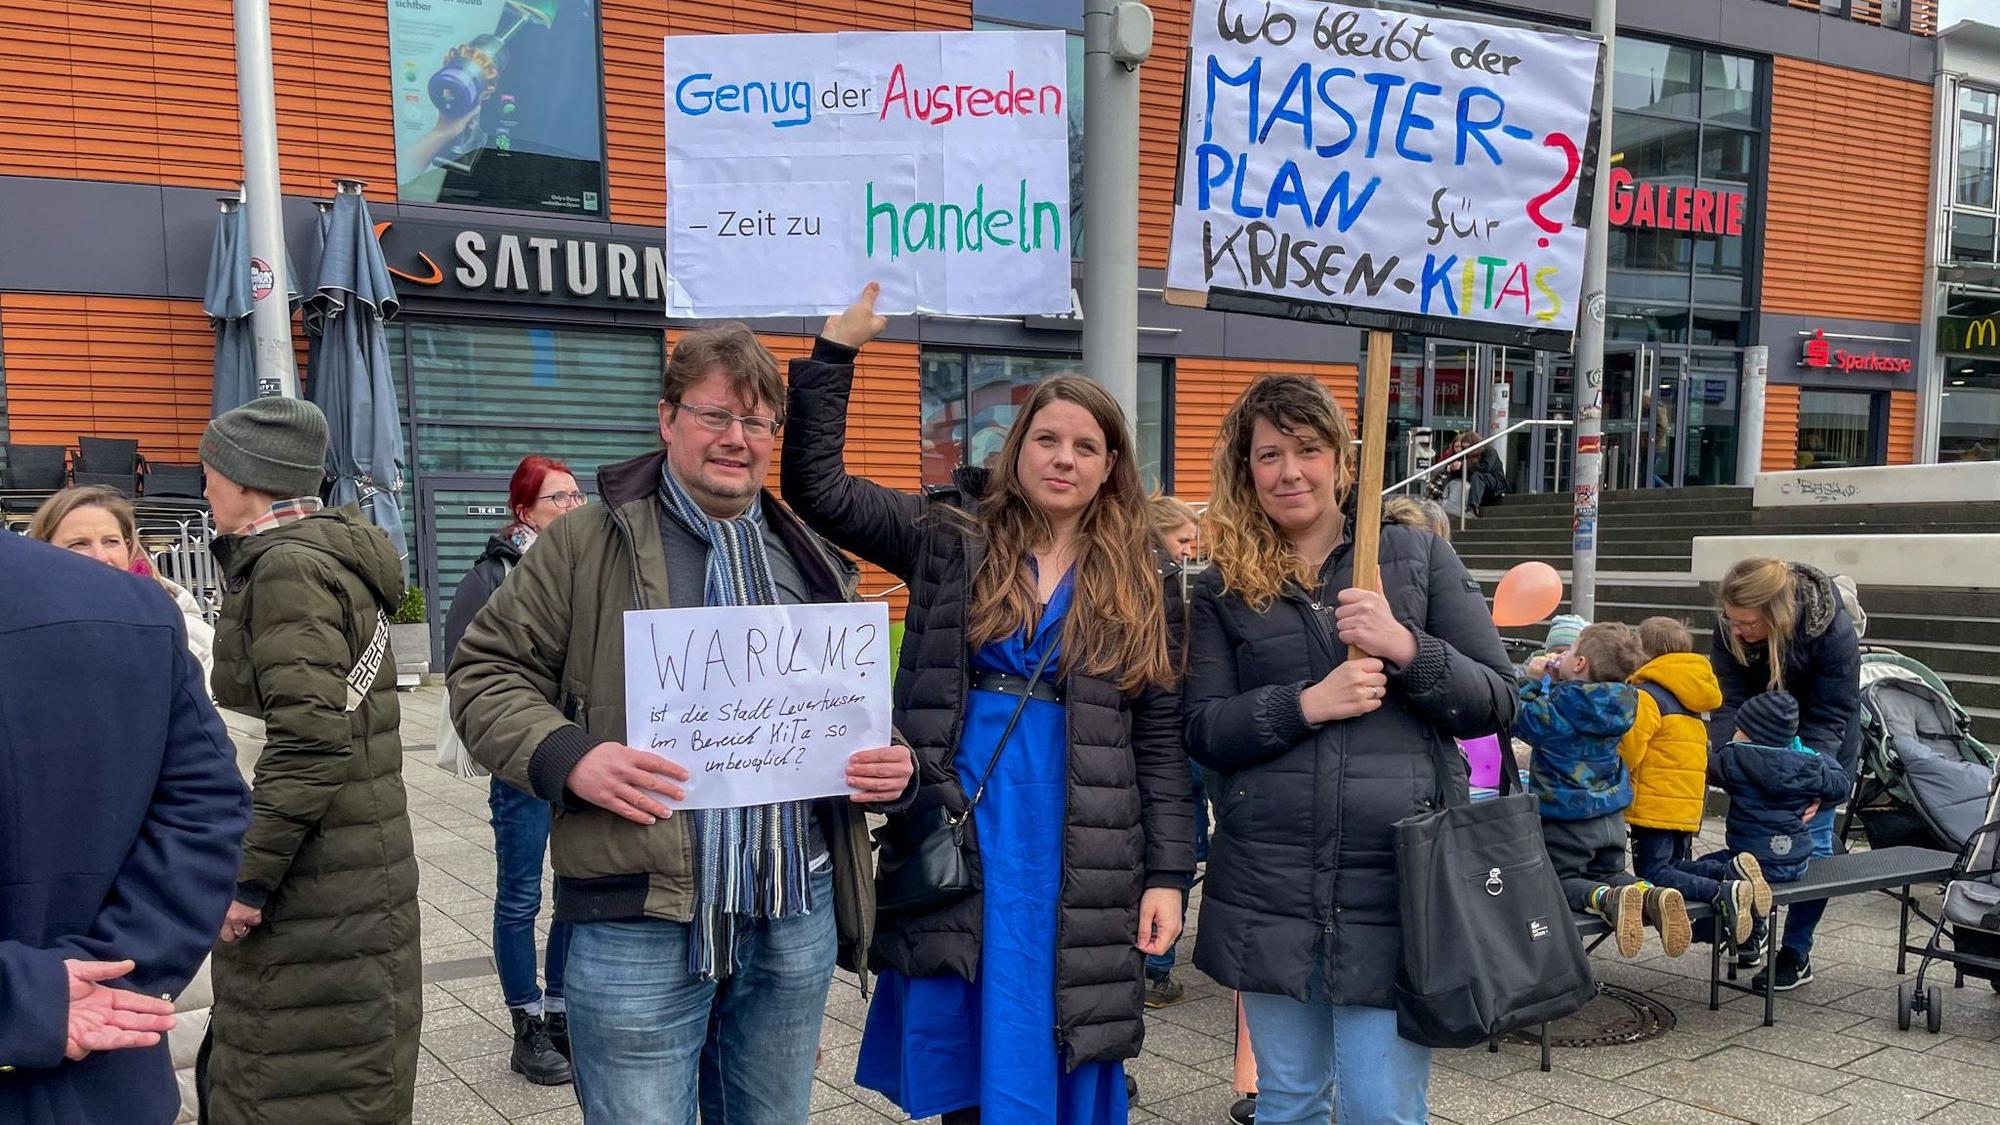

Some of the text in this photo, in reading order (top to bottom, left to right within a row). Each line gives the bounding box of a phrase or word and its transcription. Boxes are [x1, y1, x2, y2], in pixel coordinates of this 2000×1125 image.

[1217, 0, 1522, 76] Wo bleibt der
[675, 63, 1062, 127] Genug der Ausreden
[1203, 55, 1533, 166] MASTER-
[717, 211, 776, 237] Zeit
[787, 216, 821, 237] zu
[865, 178, 1061, 262] handeln
[1195, 143, 1501, 245] PLAN für
[1609, 167, 1744, 236] GALERIE
[455, 230, 666, 300] SATURN
[1833, 350, 1912, 373] Sparkasse
[651, 623, 876, 691] WARUM?
[651, 704, 668, 722] ist
[681, 703, 708, 724] die
[717, 697, 774, 721] Stadt
[651, 718, 847, 751] im Bereich KiTa so
